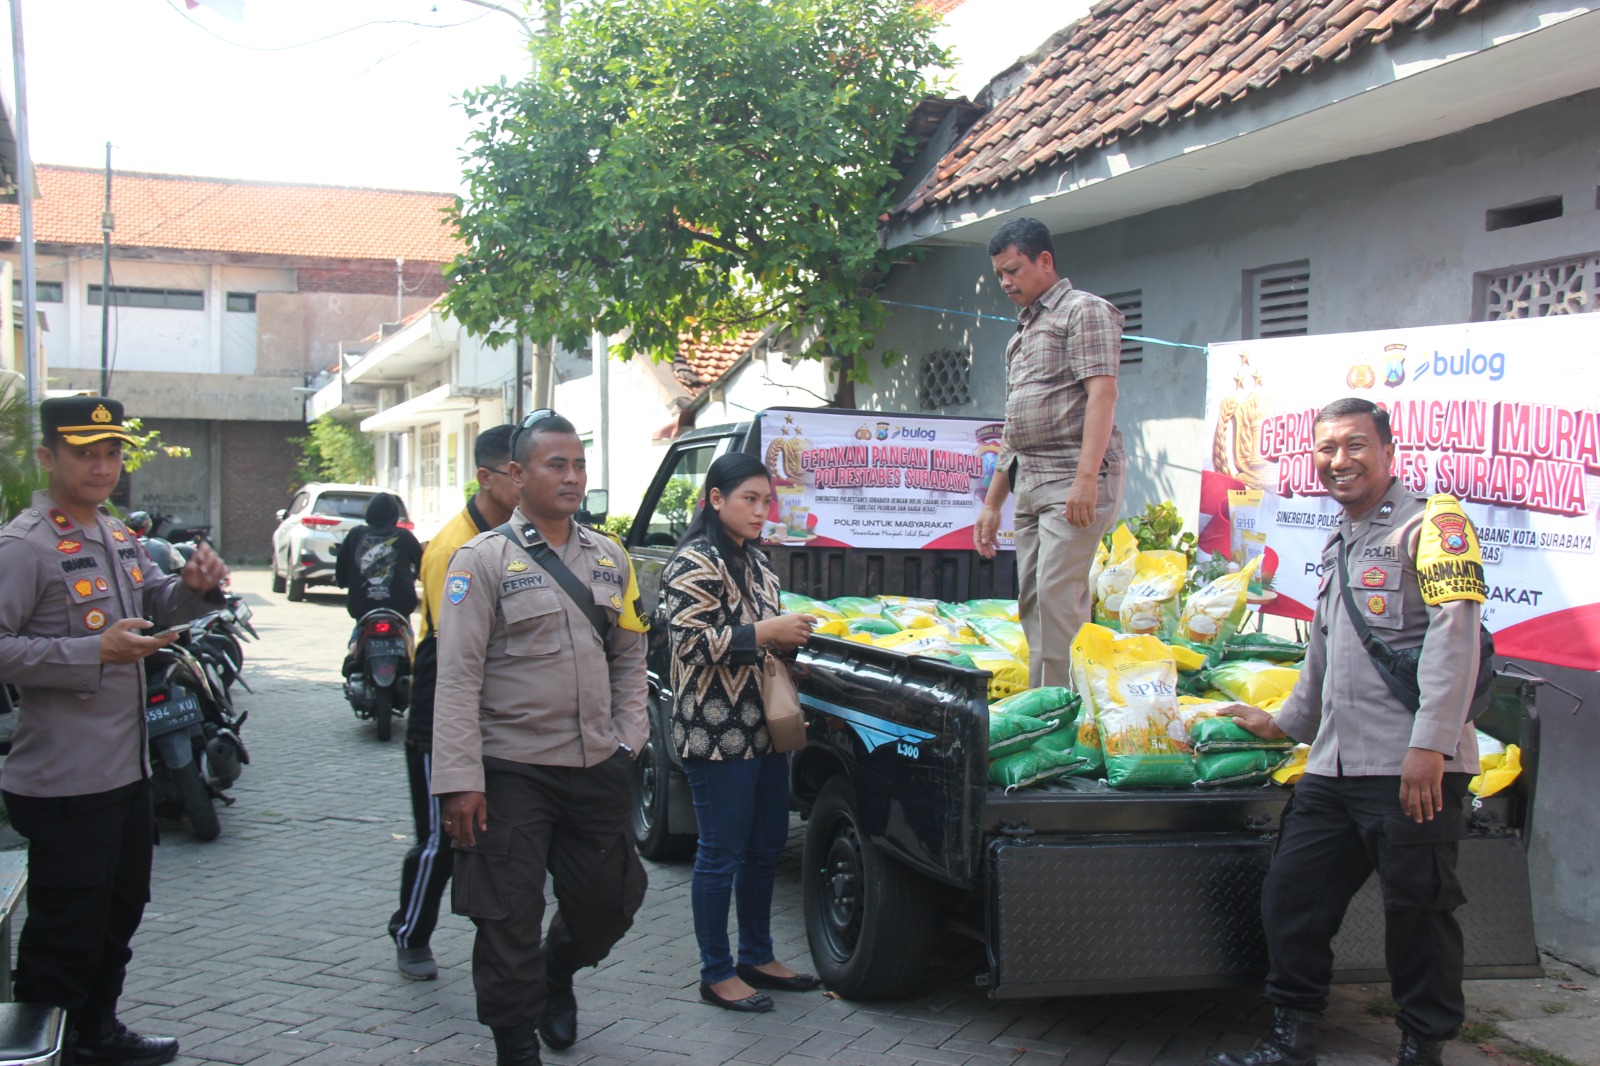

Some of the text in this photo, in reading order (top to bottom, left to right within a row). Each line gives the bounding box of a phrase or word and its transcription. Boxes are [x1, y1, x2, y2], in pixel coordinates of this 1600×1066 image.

[1433, 348, 1505, 381] bulog
[902, 427, 936, 441] bulog
[801, 445, 984, 478] GERAKAN PANGAN MURAH
[814, 467, 971, 493] POLRESTABES SURABAYA
[1436, 450, 1591, 512] SURABAYA
[834, 519, 953, 529] POLRI UNTUK MASYARAKAT
[1235, 517, 1256, 529] SPHP
[1276, 511, 1315, 526] SINERGITAS
[1512, 532, 1536, 546] KOTA
[1539, 533, 1592, 550] SURABAYA
[1363, 545, 1396, 558] POLRI
[502, 576, 543, 593] FERRY
[897, 742, 919, 759] L300
